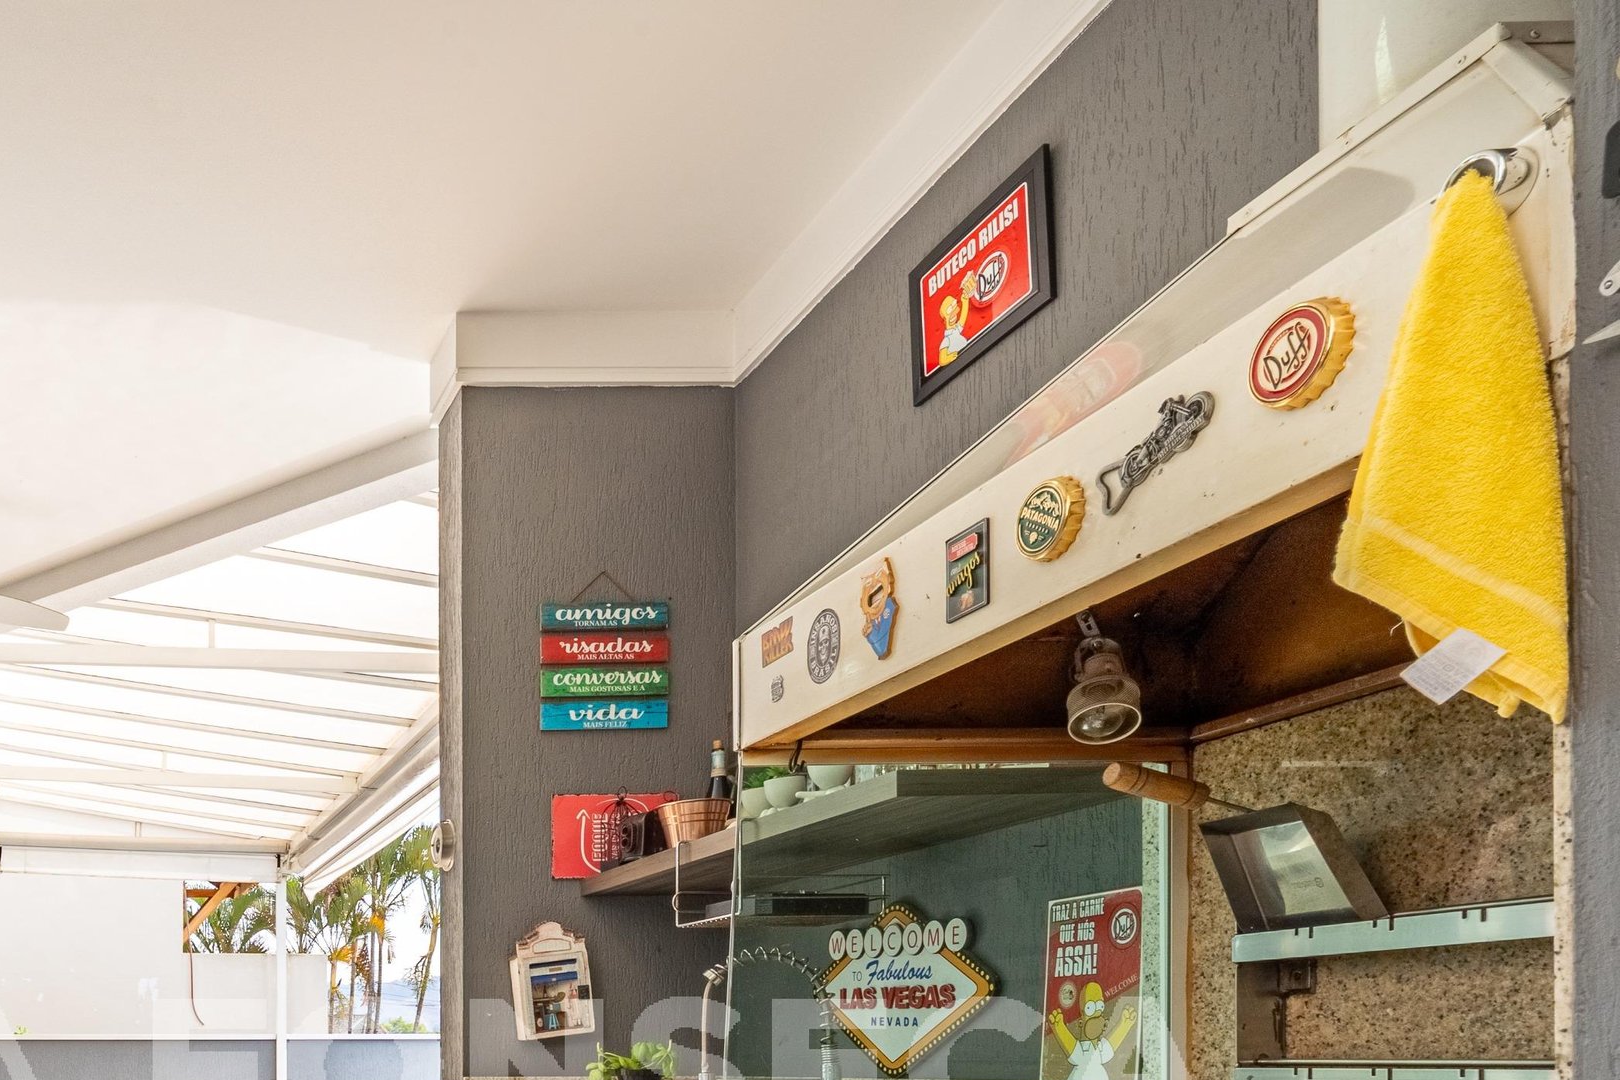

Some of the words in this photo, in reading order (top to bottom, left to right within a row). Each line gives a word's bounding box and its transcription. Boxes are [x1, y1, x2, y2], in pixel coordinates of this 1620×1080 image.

[928, 238, 976, 297] BUTECO
[978, 198, 1019, 252] RILISI
[978, 253, 1002, 300] Duff
[1263, 321, 1310, 390] Duff
[1020, 506, 1060, 532] PATAGONIA
[555, 603, 659, 625] amigos
[559, 637, 654, 653] risadas
[552, 670, 663, 686] conversas
[569, 703, 645, 721] vida
[604, 720, 628, 728] FELIZ
[1052, 904, 1070, 922] TRAZ
[1072, 902, 1078, 920] A
[1080, 898, 1105, 918] CARNE
[830, 925, 961, 955] WELCOME
[1060, 923, 1075, 944] QUE
[1077, 919, 1095, 941] NÓS
[852, 971, 862, 982] TO
[866, 960, 932, 985] Fabulous
[1055, 943, 1098, 978] ASSA!
[840, 986, 877, 1009] LAS
[881, 983, 956, 1009] VEGAS
[871, 1017, 919, 1027] NEVADA
